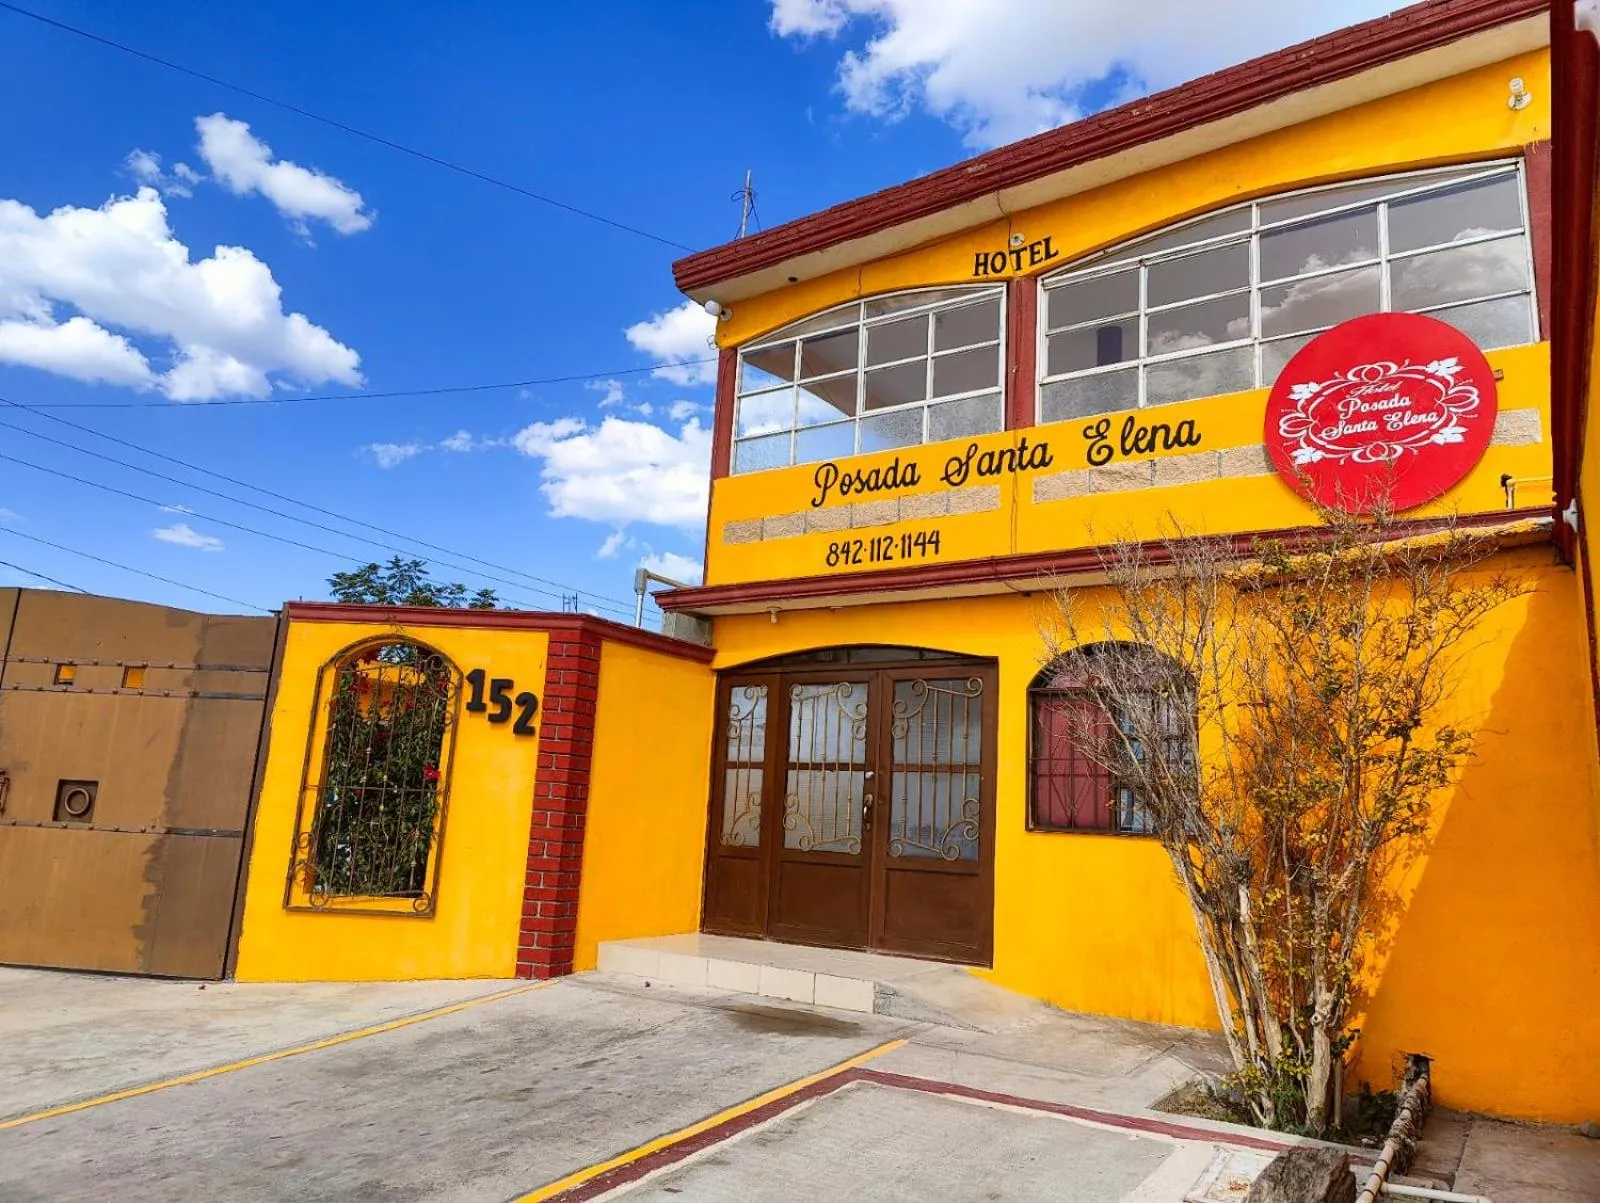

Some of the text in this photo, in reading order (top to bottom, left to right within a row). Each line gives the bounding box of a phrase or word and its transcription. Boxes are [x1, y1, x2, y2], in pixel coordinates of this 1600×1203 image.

[973, 237, 1059, 276] HOTEL
[1338, 393, 1412, 419] Posada
[1347, 381, 1403, 398] Hotel
[1319, 411, 1440, 441] Santa Elena
[811, 416, 1202, 507] Posada Santa Elena
[465, 668, 539, 735] 152
